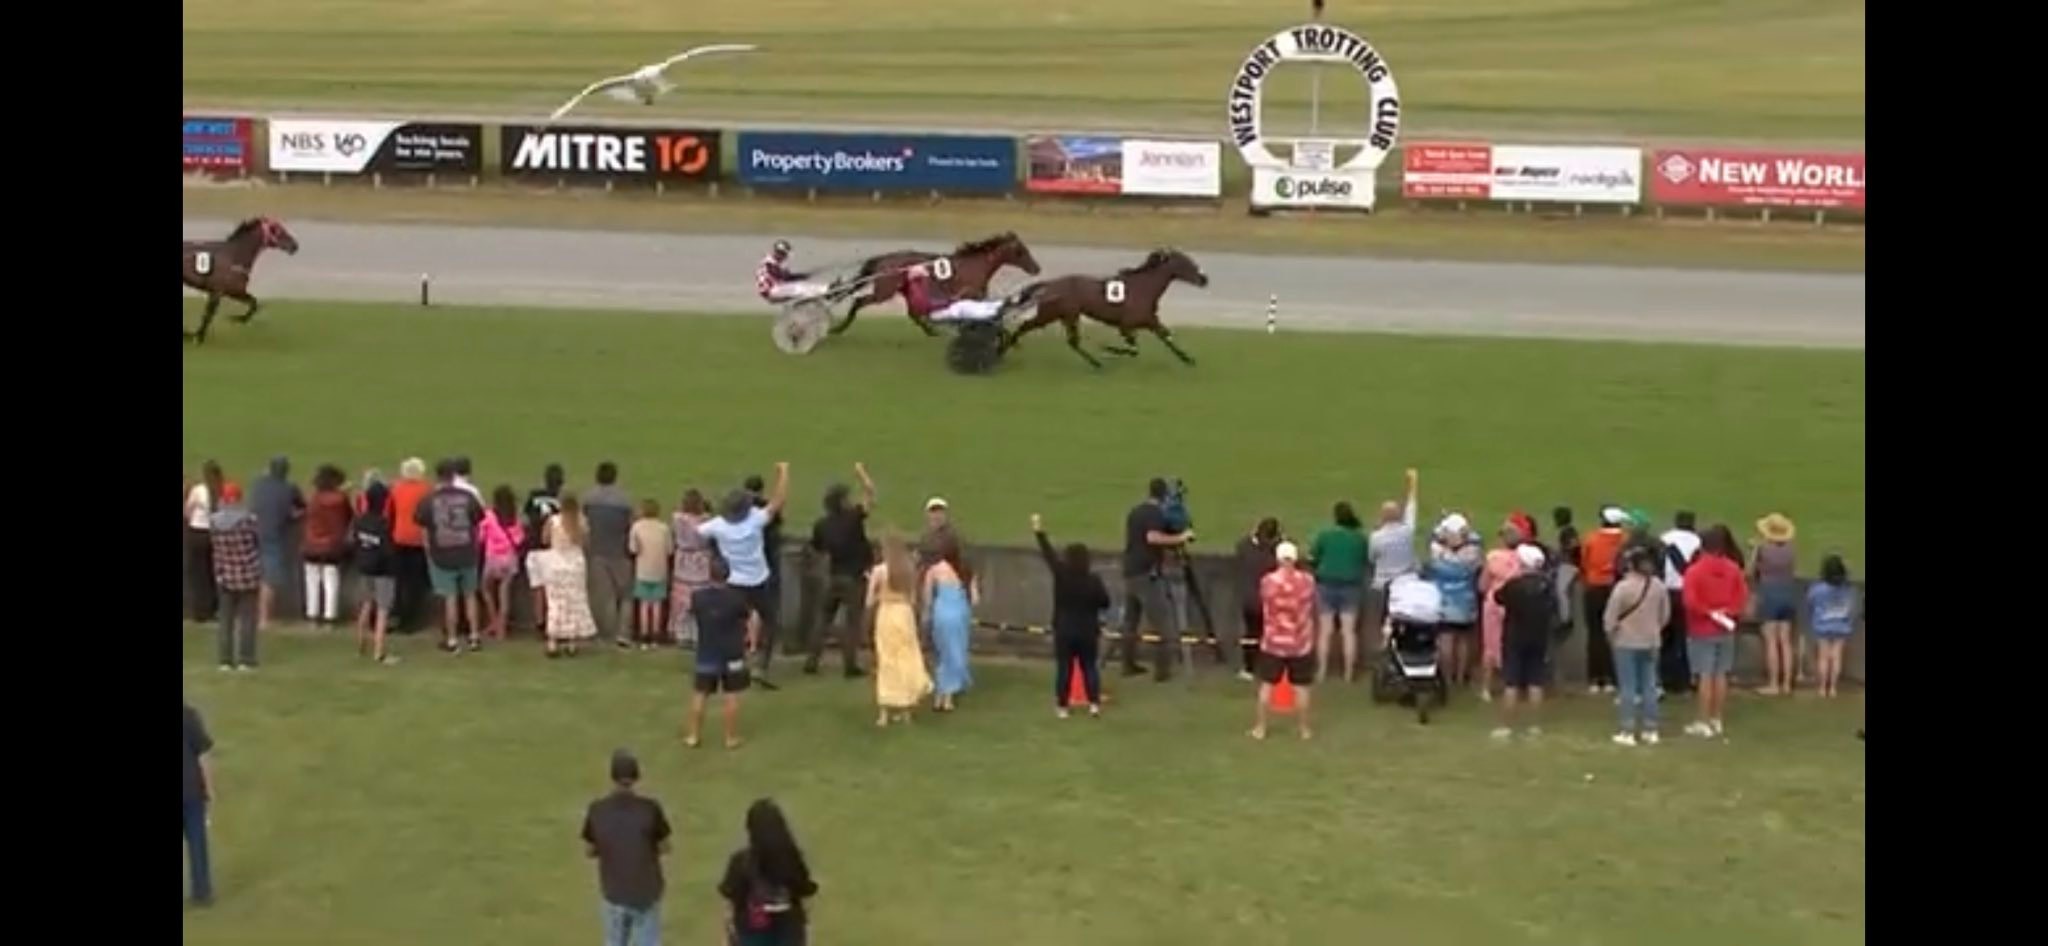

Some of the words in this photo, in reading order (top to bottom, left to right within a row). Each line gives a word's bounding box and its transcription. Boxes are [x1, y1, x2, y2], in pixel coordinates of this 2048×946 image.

[1231, 39, 1281, 147] WESTPORT
[1291, 28, 1388, 83] TROTTING
[1370, 96, 1399, 150] CLUB
[281, 131, 325, 151] NBS
[512, 133, 646, 172] MITRE
[655, 135, 709, 174] 10
[1775, 159, 1865, 187] WORL
[1297, 177, 1352, 199] pulse
